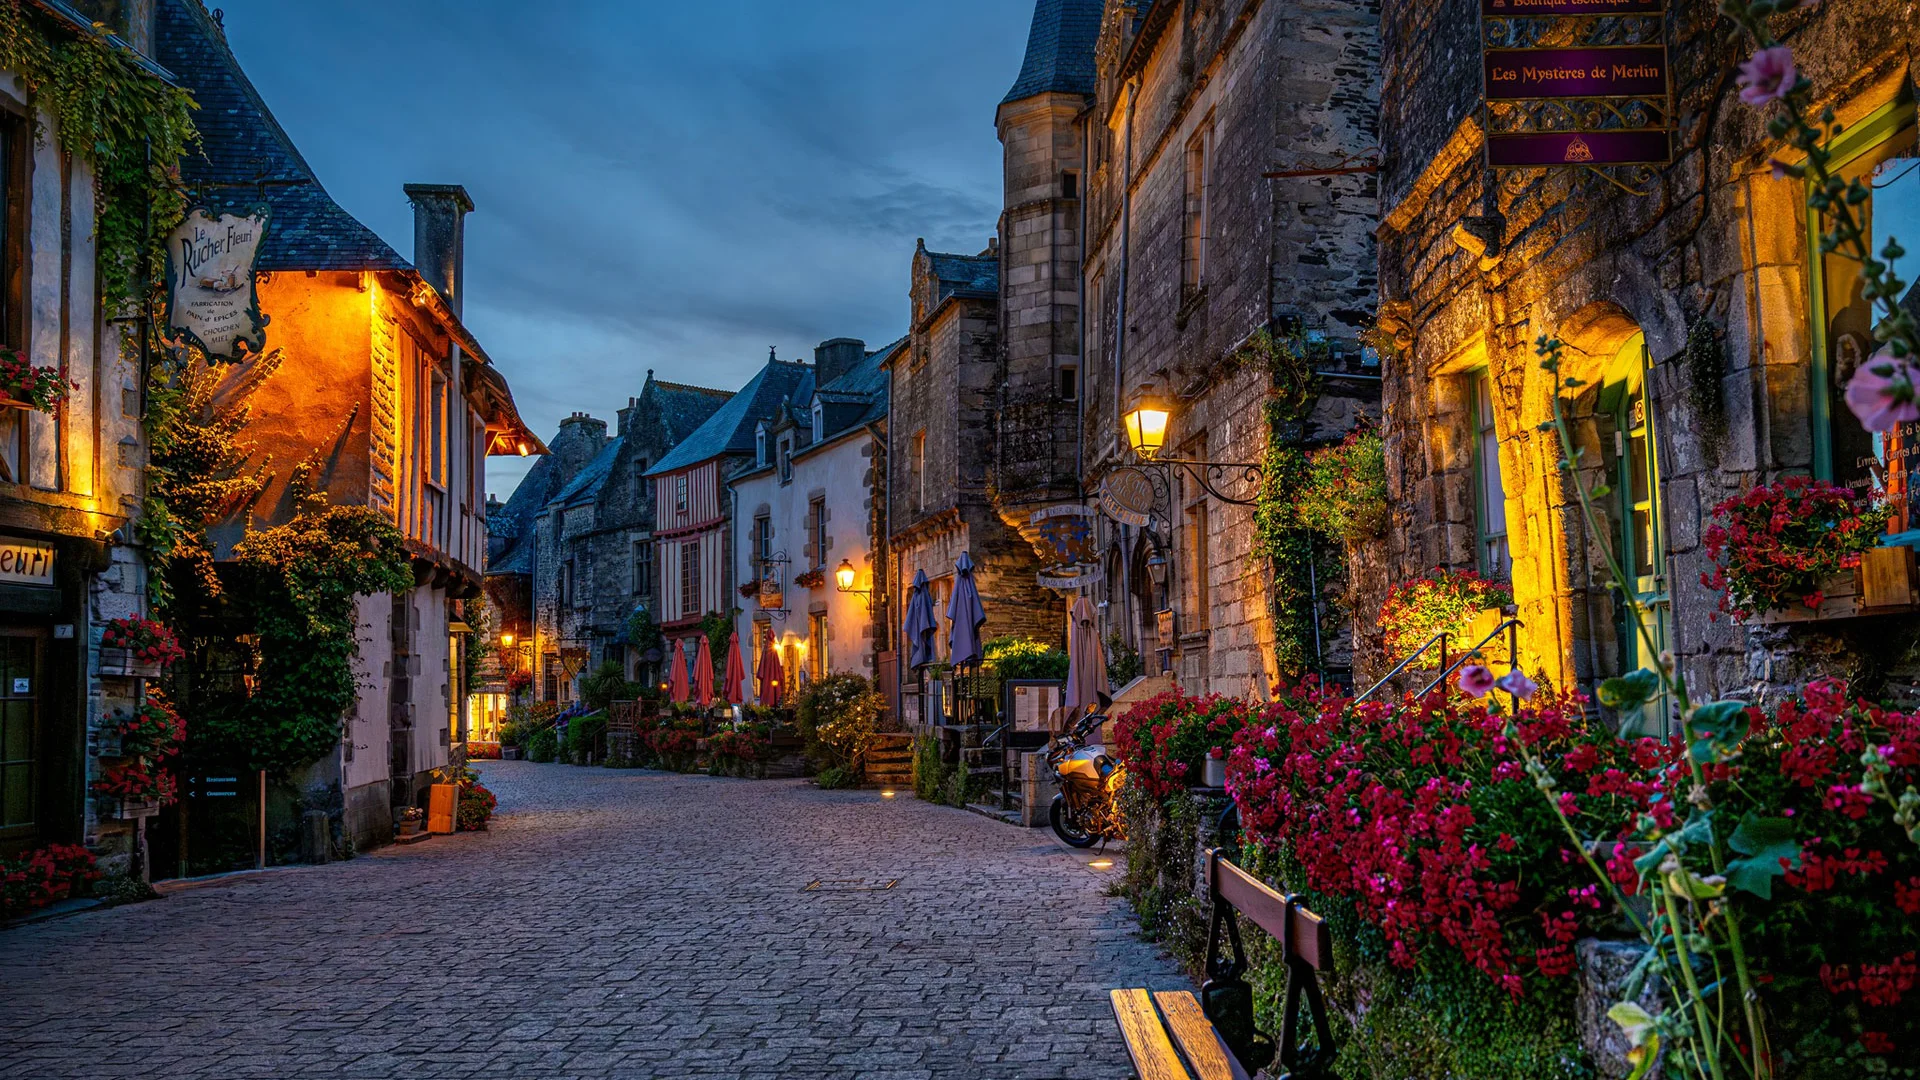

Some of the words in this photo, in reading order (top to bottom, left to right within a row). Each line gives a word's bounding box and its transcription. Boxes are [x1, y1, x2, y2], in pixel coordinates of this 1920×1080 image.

[1491, 66, 1517, 81] Les
[1521, 65, 1586, 84] Mystères
[1590, 65, 1607, 80] de
[1611, 64, 1659, 82] Merlin
[195, 226, 206, 243] Le
[180, 237, 226, 289] Rucher
[226, 224, 253, 254] Fleuri
[186, 309, 204, 321] PAIN
[203, 322, 241, 337] CHOUCHEN
[211, 335, 229, 344] MIEL
